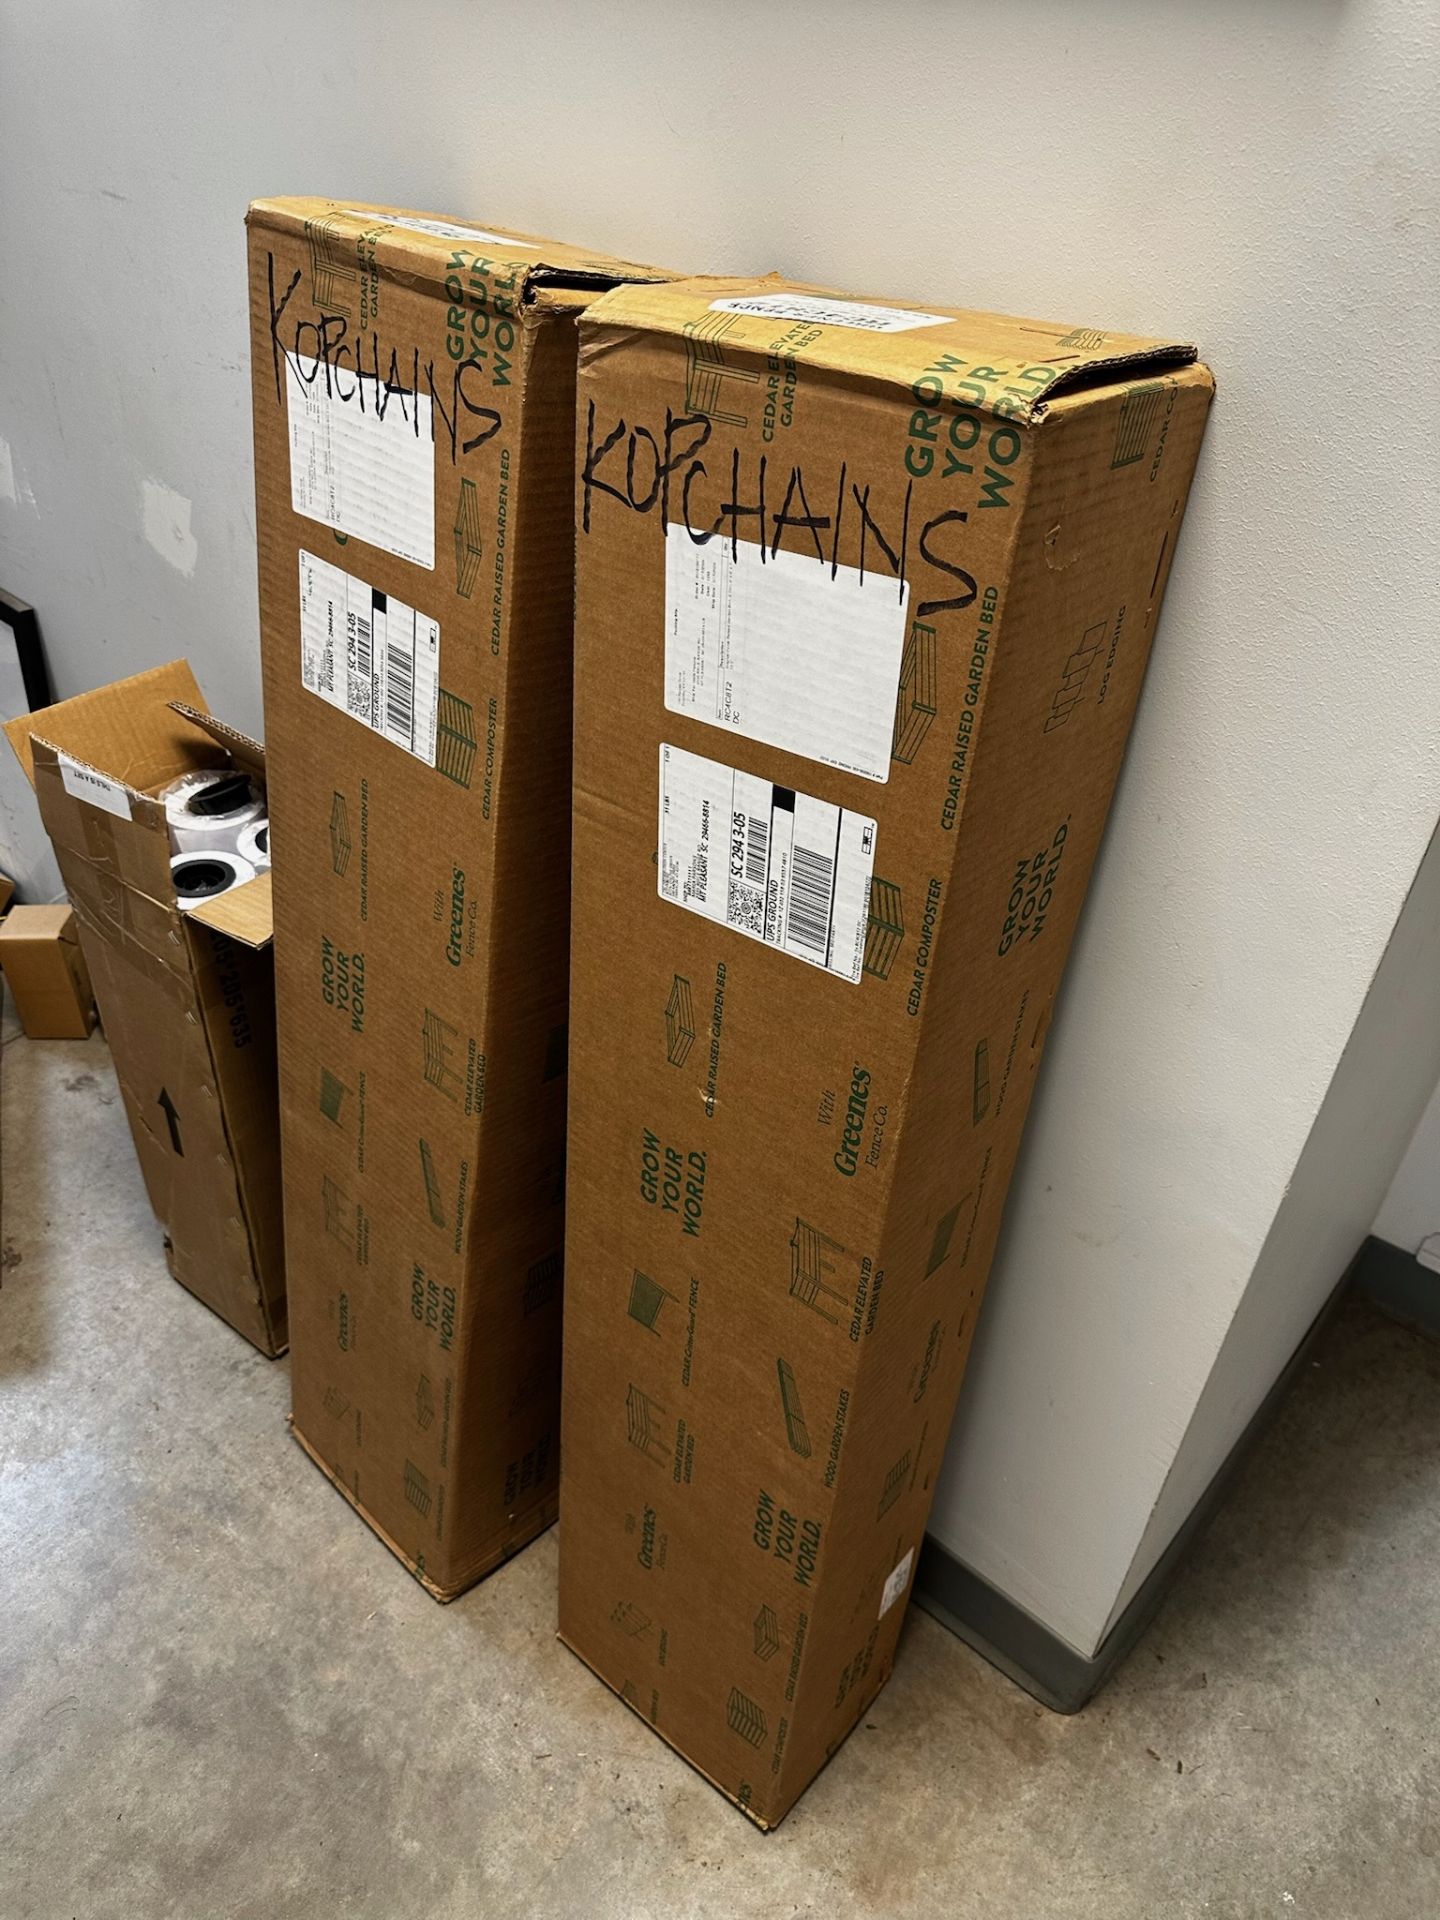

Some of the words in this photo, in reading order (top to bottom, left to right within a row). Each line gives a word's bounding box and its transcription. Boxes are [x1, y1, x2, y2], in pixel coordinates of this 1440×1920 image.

[360, 275, 369, 330] CEDAR
[367, 249, 379, 318] GARDEN
[445, 249, 474, 360] GROW
[469, 257, 496, 362] YOUR
[780, 347, 800, 428] GARDEN
[797, 329, 823, 348] BED
[763, 375, 779, 443] CEDAR
[904, 354, 968, 478] GROW
[941, 366, 1009, 479] YOUR
[499, 449, 510, 481] BED
[1150, 419, 1170, 482] CEDAR
[497, 482, 508, 549] GARDEN
[491, 552, 505, 607] RAISED
[348, 611, 356, 635] 3-05
[348, 637, 356, 655] 294
[488, 607, 502, 656] CEDAR
[1105, 605, 1126, 669] EDGING
[348, 655, 356, 671] SC
[732, 711, 740, 725] DC
[941, 775, 963, 831] CEDAR
[952, 710, 974, 772] RAISED
[965, 628, 990, 706] GARDEN
[980, 586, 998, 625] BED
[484, 699, 498, 776] COMPOSTER
[361, 779, 369, 801] BED
[482, 780, 493, 820] CEDAR
[361, 803, 369, 847] GARDEN
[701, 842, 709, 853] SC
[733, 812, 745, 839] 3-05
[699, 855, 708, 890] PLEASANT
[731, 863, 743, 878] SC
[732, 841, 744, 861] 294
[698, 890, 707, 902] MT
[767, 879, 778, 922] GROUND
[1015, 848, 1048, 943] YOUR
[1029, 813, 1072, 942] WORLD.
[360, 889, 368, 921] CEDAR
[433, 889, 444, 922] With
[445, 867, 466, 967] Greenes
[998, 860, 1029, 957] GROW
[766, 923, 776, 941] UPS
[907, 969, 925, 1017] CEDAR
[917, 878, 942, 968] COMPOSTER
[321, 934, 334, 1005] GROW
[336, 951, 350, 1013] YOUR
[352, 952, 365, 1033] WORLD.
[718, 962, 727, 987] BED
[713, 989, 724, 1039] GARDEN
[467, 1037, 476, 1079] ELEVATED
[478, 1054, 486, 1073] BED
[709, 1040, 721, 1081] RAISED
[464, 1082, 473, 1117] CEDAR
[475, 1075, 484, 1113] GARDEN
[817, 1089, 836, 1128] With
[872, 1104, 888, 1126] Co.
[833, 1065, 871, 1177] Greenes
[640, 1127, 660, 1204] GROW
[865, 1127, 884, 1169] Fence
[460, 1160, 468, 1189] STAKES
[662, 1147, 683, 1214] YOUR
[682, 1151, 707, 1238] WORLD.
[457, 1190, 465, 1224] GARDEN
[411, 1264, 425, 1320] GROW
[424, 1280, 440, 1331] YOUR
[855, 1257, 872, 1307] ELEVATED
[872, 1270, 884, 1292] BED
[440, 1287, 456, 1351] WORLD.
[682, 1357, 691, 1386] CEDAR
[688, 1278, 699, 1308] FENCE
[848, 1307, 863, 1342] CEDAR
[865, 1293, 881, 1335] GARDEN
[836, 1389, 850, 1426] STAKES
[828, 1427, 843, 1463] GARDEN
[824, 1462, 836, 1488] WOOD
[753, 1488, 776, 1551] GROW
[774, 1510, 798, 1565] YOUR
[793, 1520, 822, 1588] WORLD.
